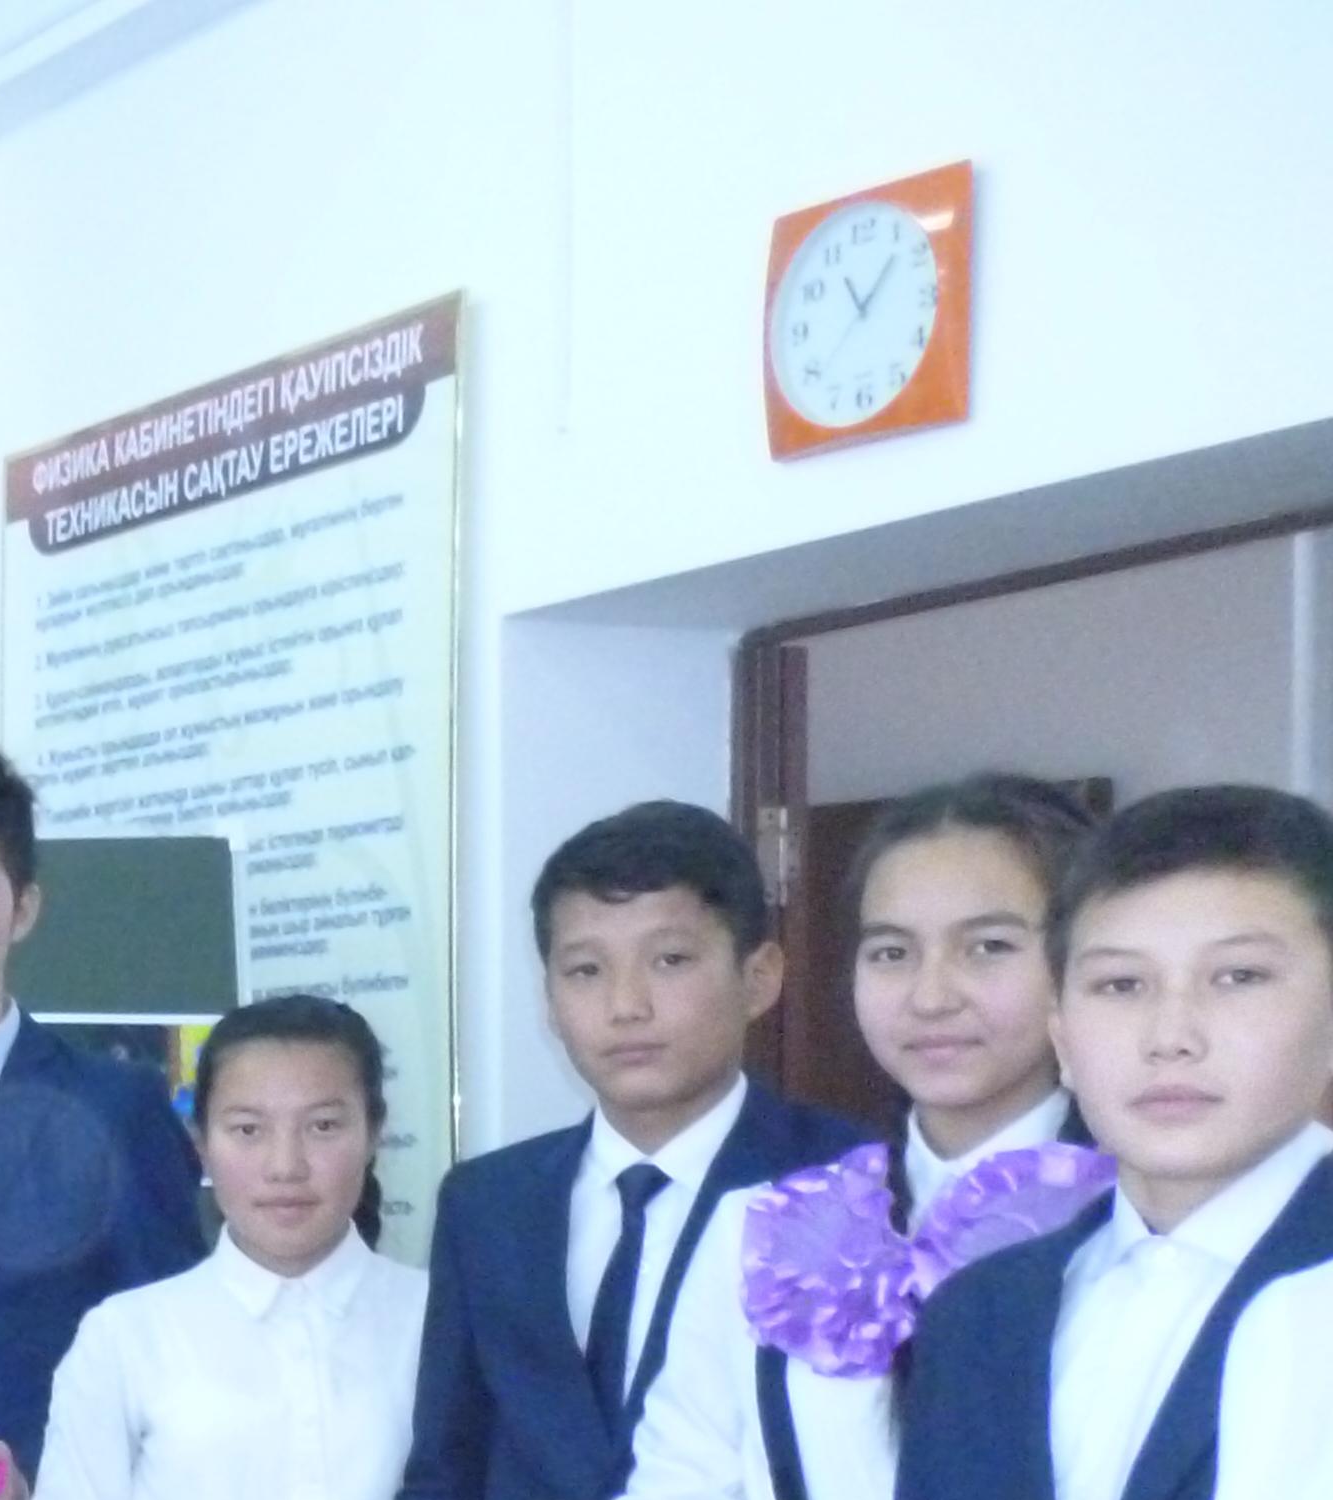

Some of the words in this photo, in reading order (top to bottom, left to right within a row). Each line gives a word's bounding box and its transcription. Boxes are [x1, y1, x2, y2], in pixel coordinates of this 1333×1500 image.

[851, 217, 876, 245] 12
[825, 243, 842, 267] 11
[912, 241, 928, 268] 2
[803, 280, 824, 304] 10
[919, 284, 937, 308] 3
[792, 322, 809, 347] 9
[803, 359, 821, 386] 8
[32, 439, 110, 495] ФИЗИКА
[113, 376, 276, 468] КАБИНЕТІНДЕГІ
[279, 324, 425, 414] ҚАУІПСІЗДІК
[855, 384, 873, 409] 6
[44, 467, 180, 546] ТЕХНИКАСЫН
[182, 441, 266, 499] САҚТАУ
[268, 394, 405, 476] ЕРЕЖЕЛЕРІ
